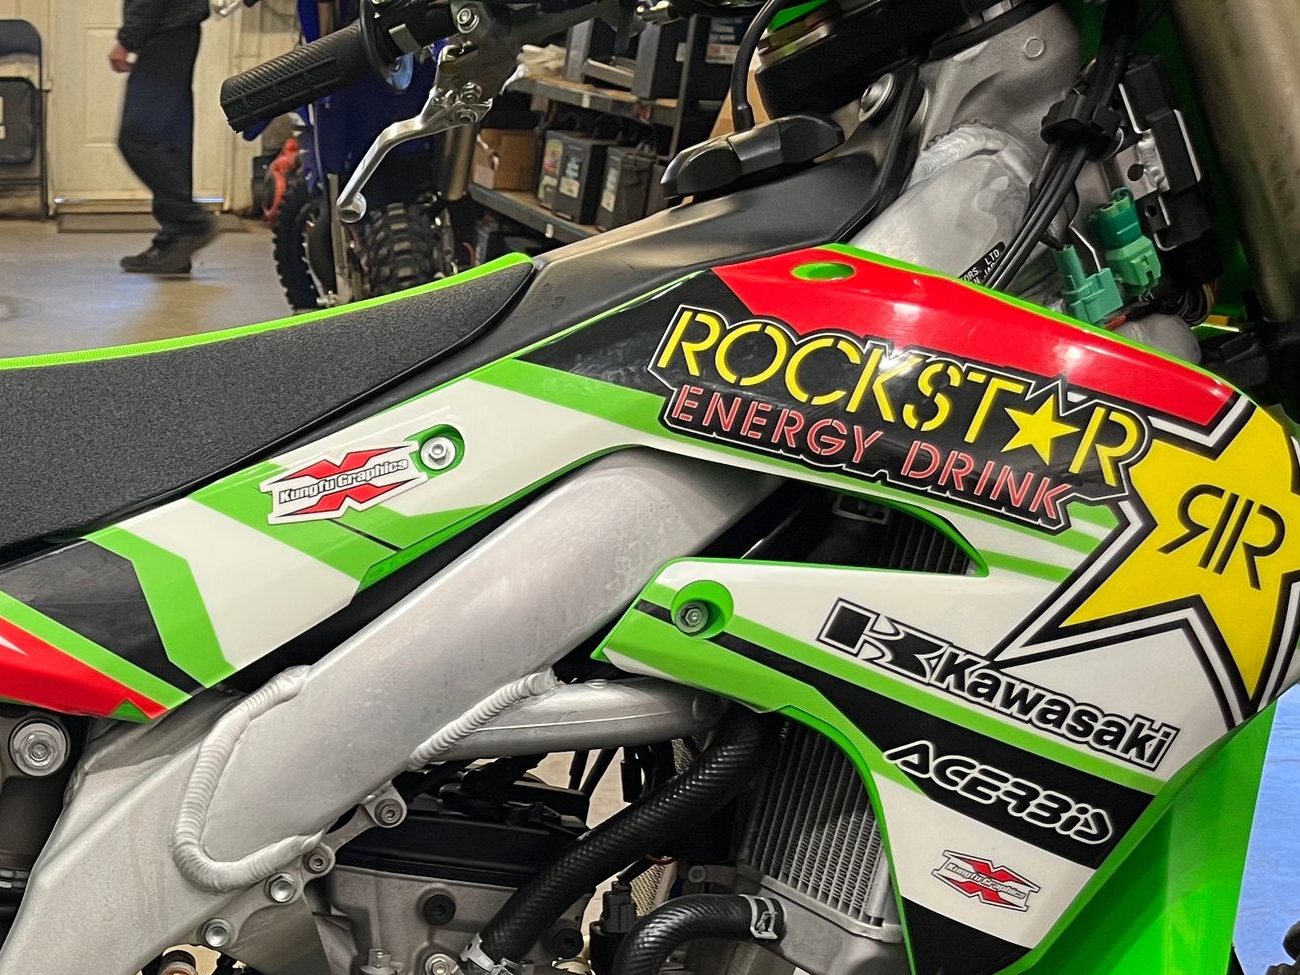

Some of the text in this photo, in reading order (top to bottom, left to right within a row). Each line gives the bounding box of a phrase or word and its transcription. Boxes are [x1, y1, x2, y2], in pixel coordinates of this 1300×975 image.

[278, 459, 409, 504] Kungfu Graphics
[672, 384, 1071, 520] ENERGY DRINK
[931, 646, 1180, 771] Kawasaki
[945, 862, 1027, 899] Kungfu Graphics
